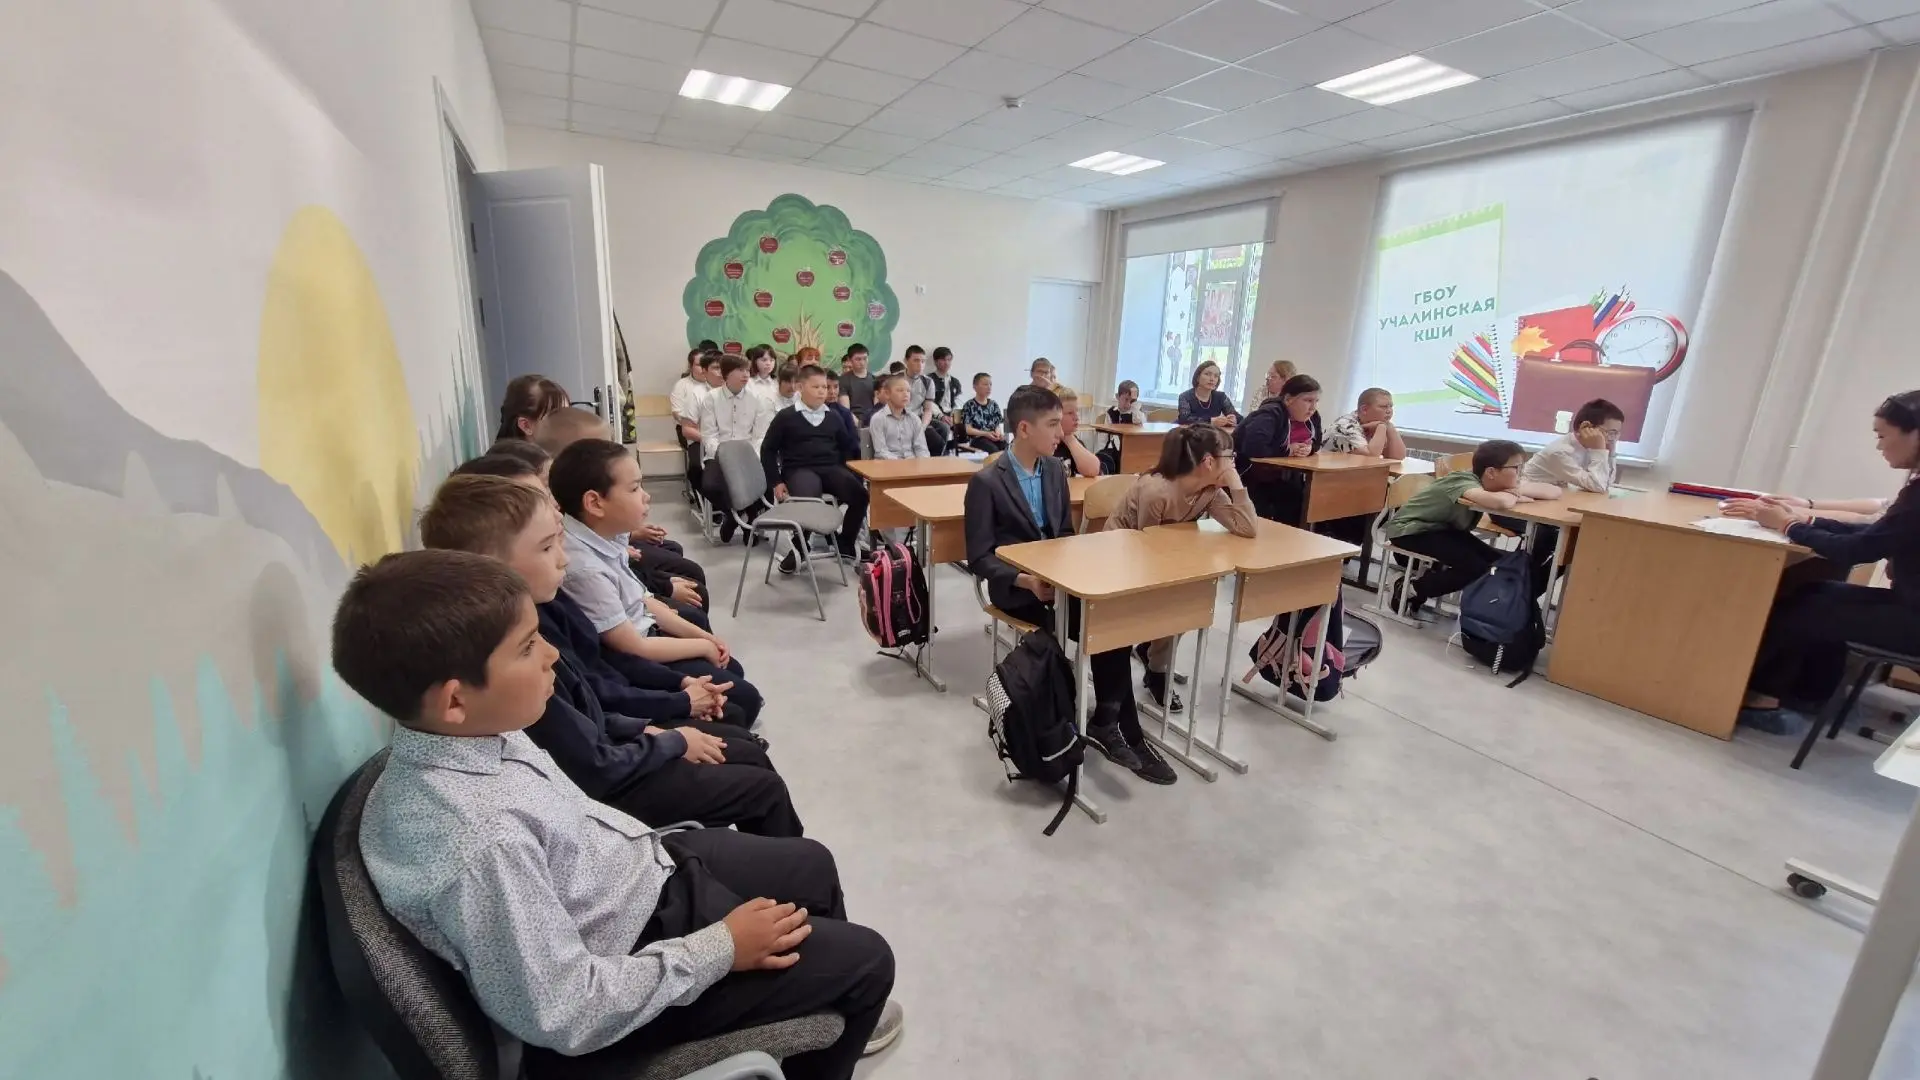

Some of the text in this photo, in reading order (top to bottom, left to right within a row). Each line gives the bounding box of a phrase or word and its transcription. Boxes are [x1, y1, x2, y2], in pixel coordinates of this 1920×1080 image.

[1414, 285, 1458, 305] ГБОУ
[1379, 297, 1495, 330] УЧАЛИНСКАЯ
[1414, 324, 1453, 343] КШИ
